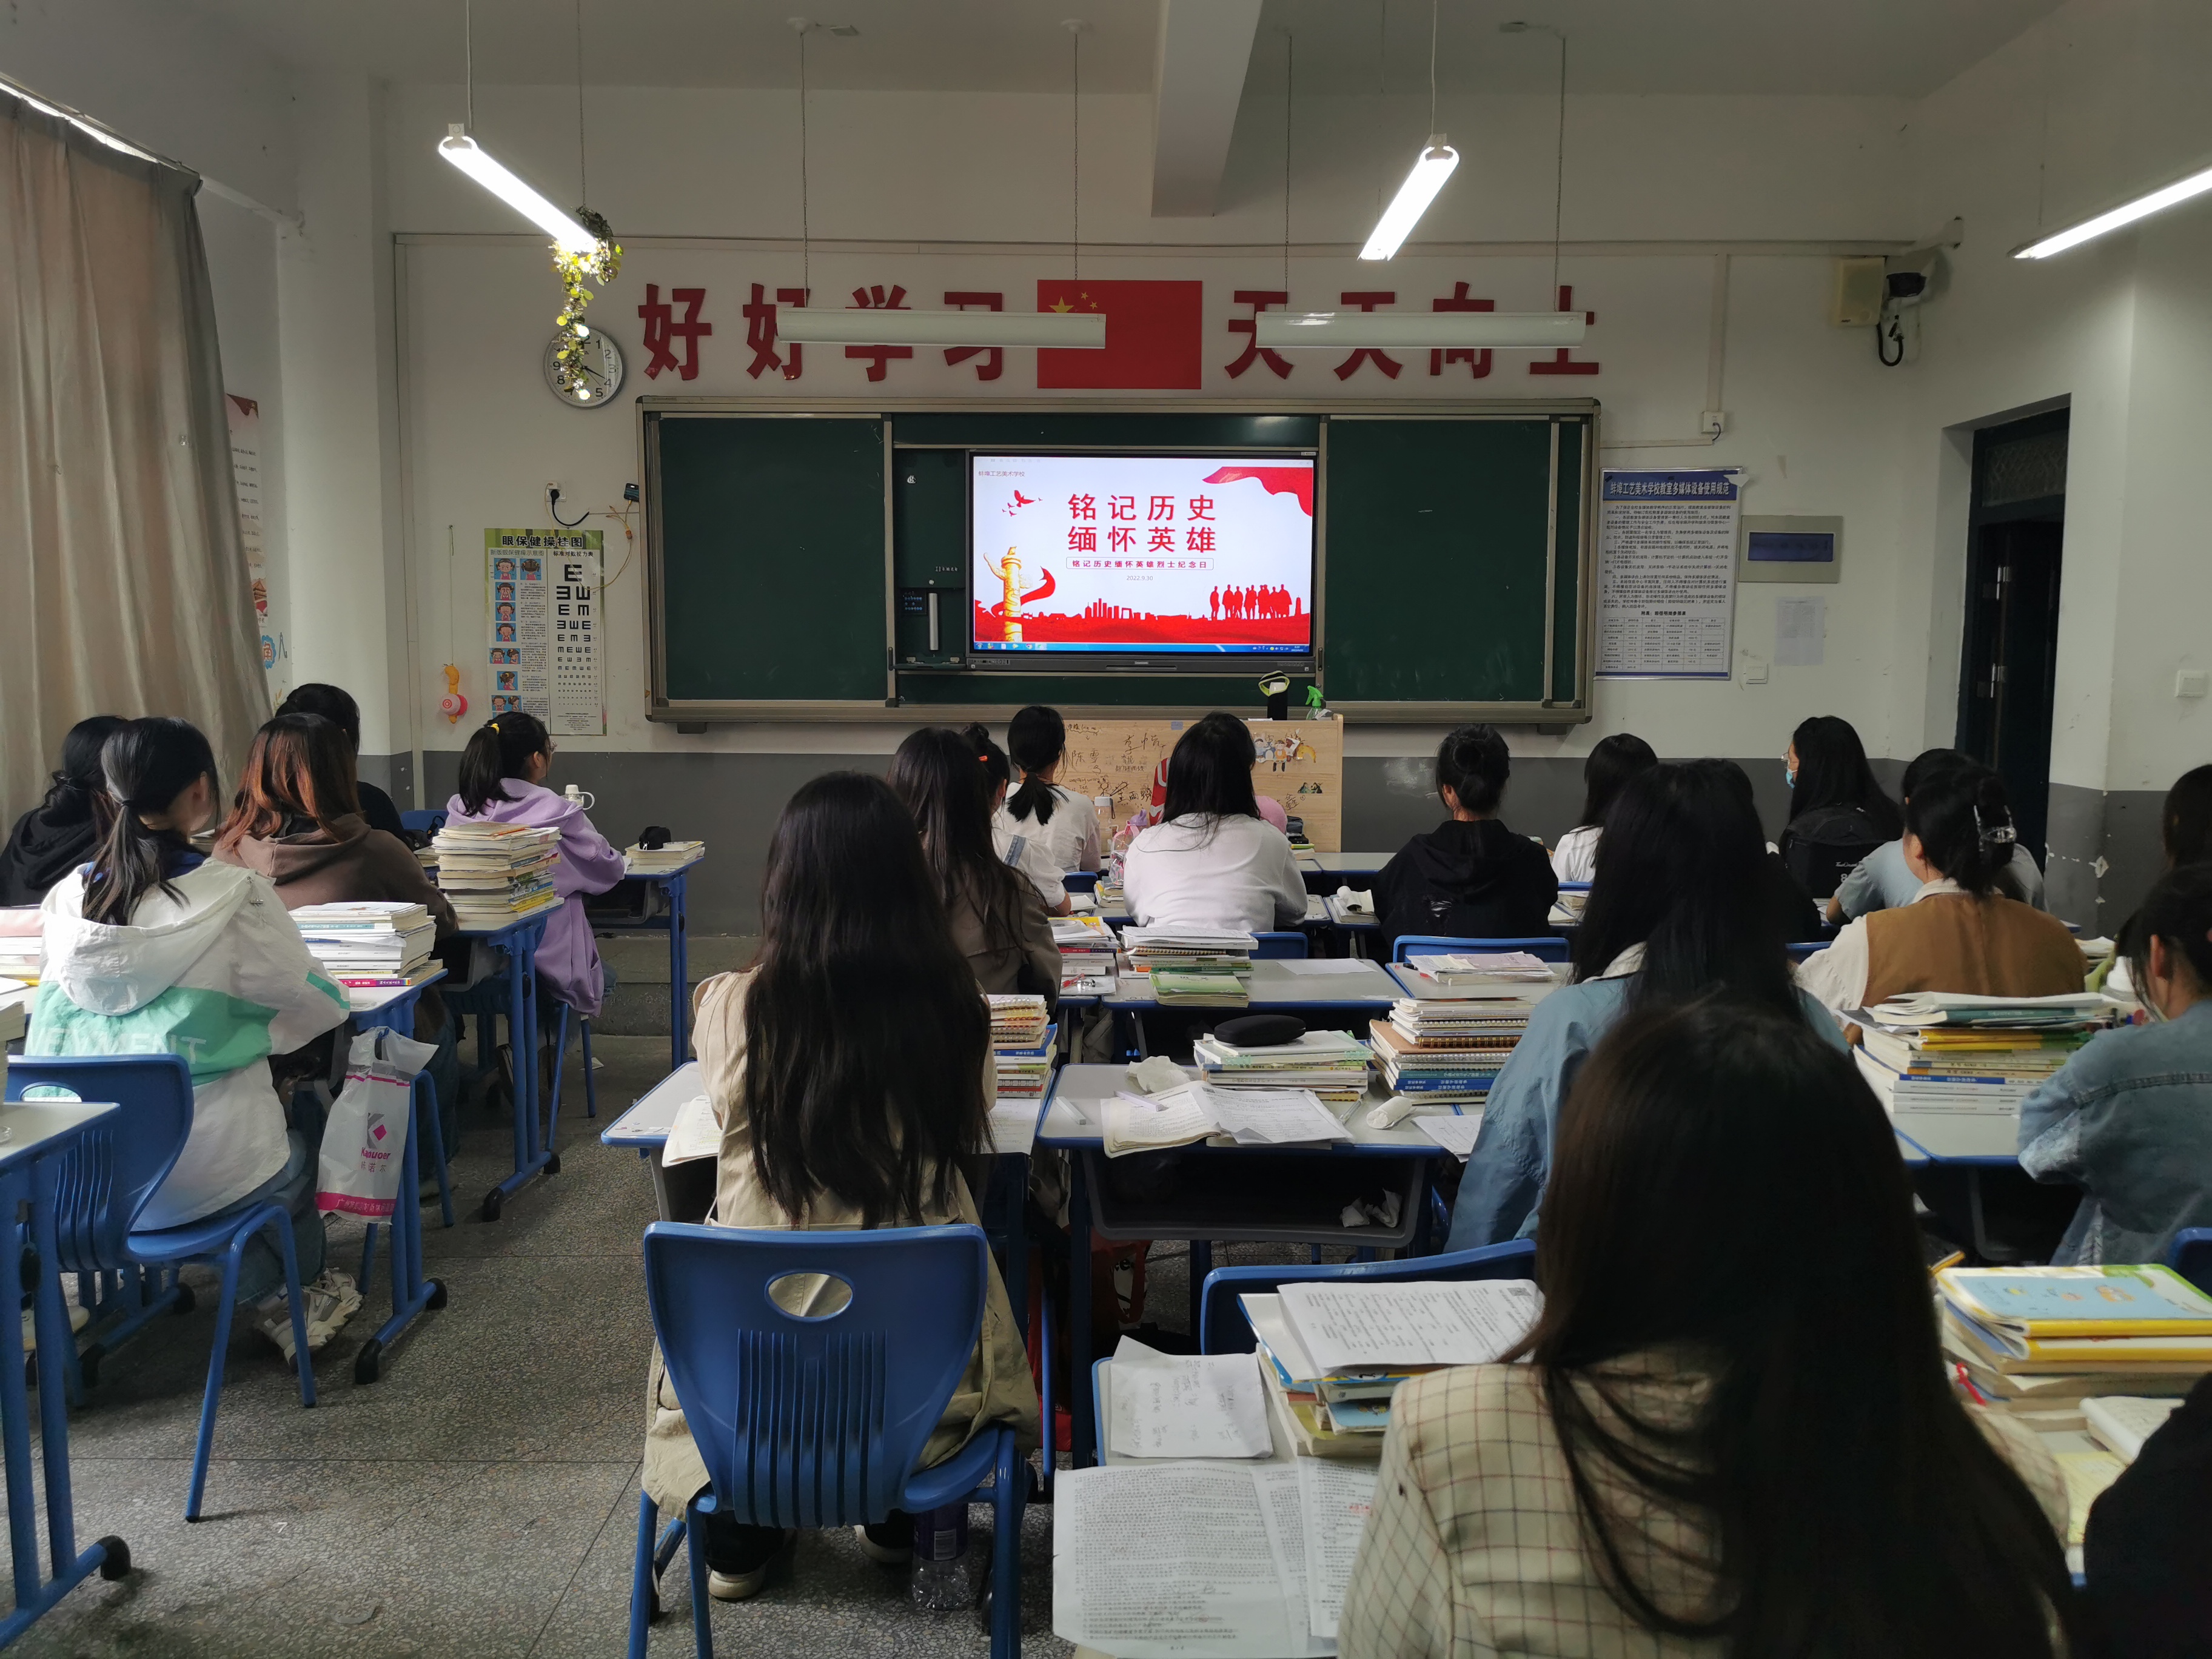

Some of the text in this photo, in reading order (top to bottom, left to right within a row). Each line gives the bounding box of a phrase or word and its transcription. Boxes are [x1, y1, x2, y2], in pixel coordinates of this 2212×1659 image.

[553, 361, 560, 370] 9
[557, 375, 565, 384] 8
[595, 388, 603, 397] 5
[1610, 481, 1730, 497] 蚌埠工艺美术学校教室多媒体设备使用规范
[1068, 493, 1216, 521] 铭记历史
[502, 536, 583, 548] 眼保健操挂图
[1068, 526, 1216, 553] 缅怀英雄
[1071, 560, 1208, 569] 铭记历史缅怀英雄烈士纪念日
